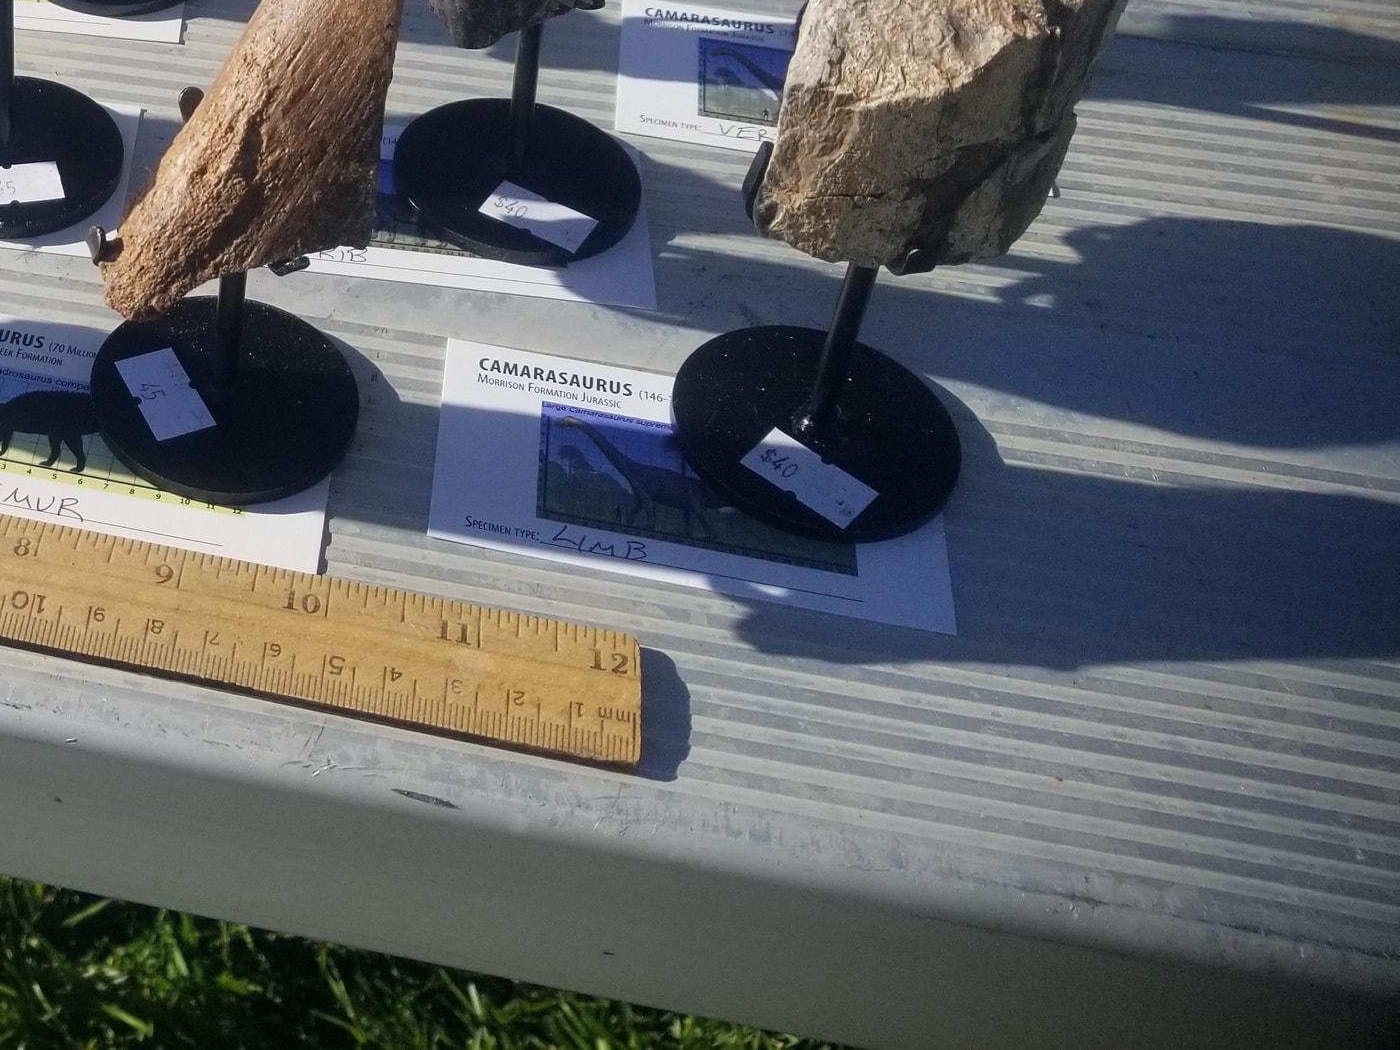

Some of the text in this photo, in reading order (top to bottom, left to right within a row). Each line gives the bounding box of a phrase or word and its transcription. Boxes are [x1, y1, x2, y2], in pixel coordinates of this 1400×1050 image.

[645, 7, 775, 34] CAMARASAURUS
[494, 195, 528, 219] $40
[48, 341, 65, 353] (70
[16, 350, 63, 367] FORMATION
[479, 358, 633, 397] CAMARASAURUS
[477, 373, 622, 409] MORRISON FORMATION JURASSIC
[541, 401, 633, 424] Large Camarasaurus
[760, 448, 799, 478] $40
[465, 515, 540, 542] SPECIMEN TYPE:
[551, 524, 648, 561] LIMB
[11, 590, 47, 614] 10
[13, 538, 32, 557] 8
[155, 564, 174, 584] 9
[282, 590, 321, 614] 10
[436, 619, 472, 646] 11
[589, 647, 629, 675] 12
[93, 607, 107, 623] 9
[150, 618, 165, 635] 8
[208, 631, 221, 646] 7
[269, 643, 282, 658] 6
[329, 655, 346, 676] 5
[389, 666, 403, 683] 4
[451, 679, 464, 695] 3
[513, 690, 525, 707] 2
[573, 701, 585, 718] 1
[598, 706, 632, 724] mm
